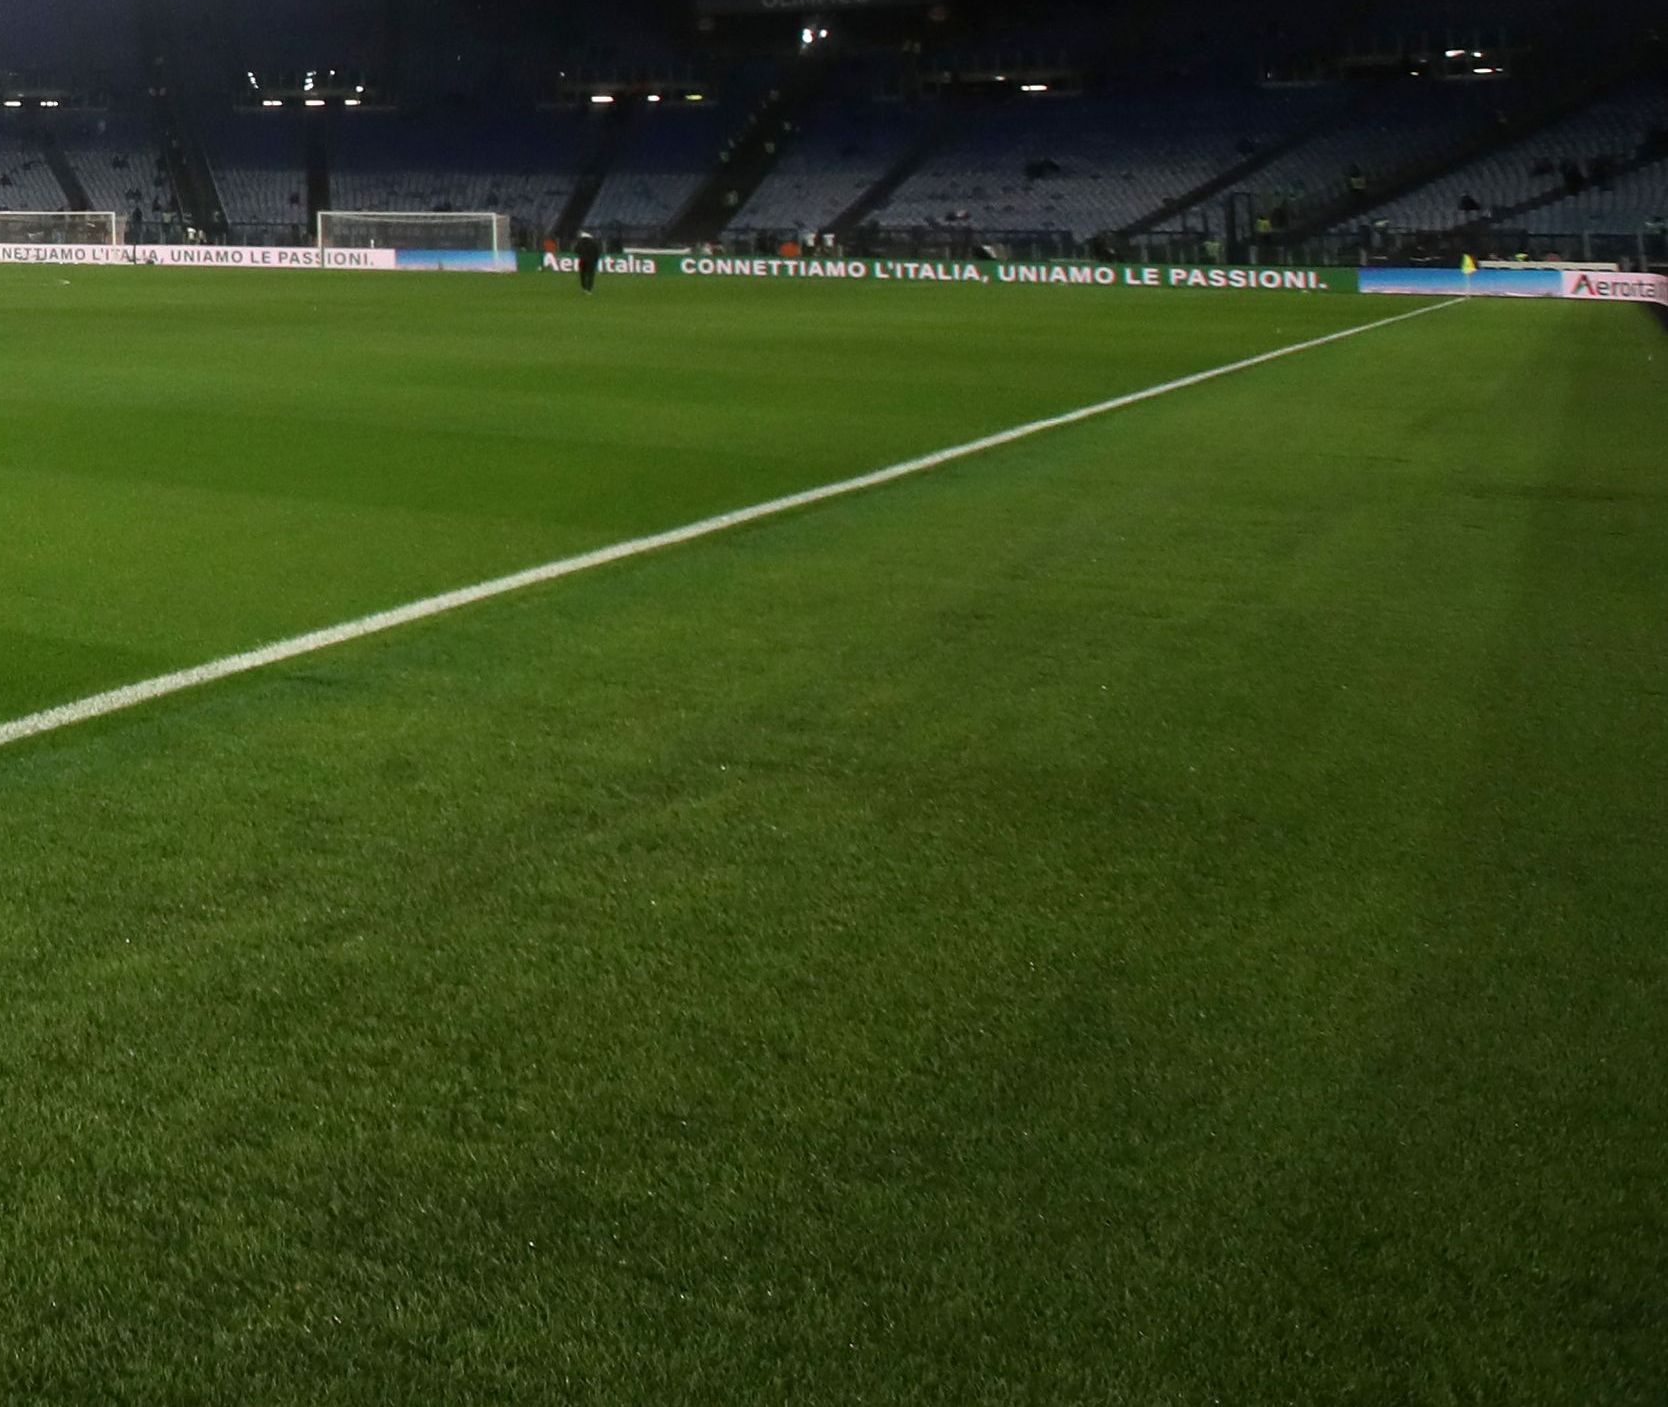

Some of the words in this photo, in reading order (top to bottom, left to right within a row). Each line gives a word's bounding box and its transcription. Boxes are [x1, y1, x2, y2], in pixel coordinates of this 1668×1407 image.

[171, 250, 243, 263] UNIAMO
[250, 251, 271, 264] LE
[538, 252, 656, 274] Aeritalia
[680, 258, 865, 278] CONNETTIAMO
[874, 262, 988, 283] L'ITALIA,
[998, 265, 1114, 284] UNIAMO
[1124, 267, 1160, 285] LE
[1168, 268, 1328, 289] PASSIONI.
